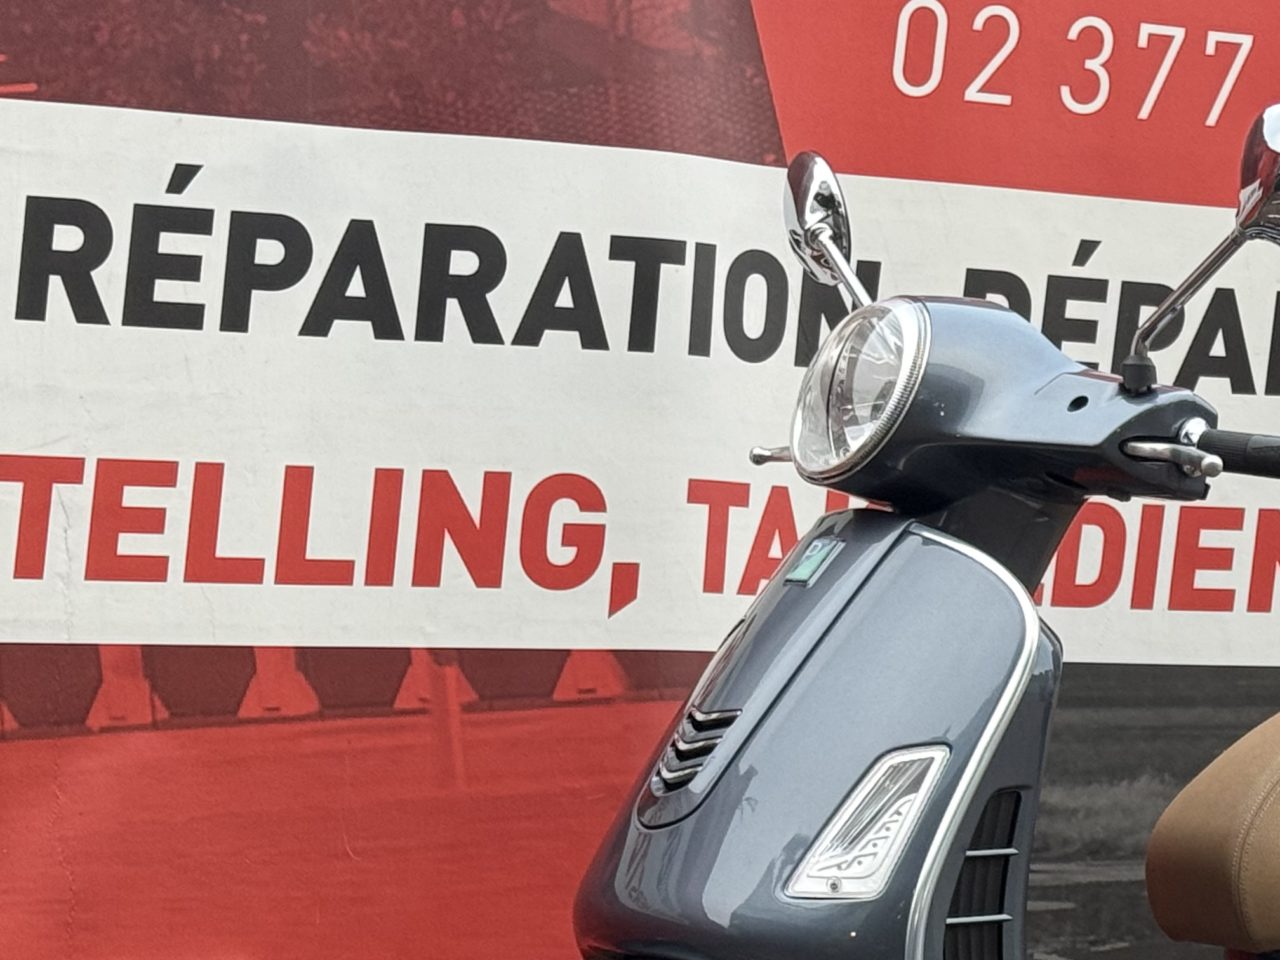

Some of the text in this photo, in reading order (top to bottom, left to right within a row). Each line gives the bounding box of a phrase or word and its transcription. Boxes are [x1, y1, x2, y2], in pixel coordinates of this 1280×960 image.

[893, 0, 1021, 107] 02
[1059, 16, 1253, 127] 377
[0, 454, 640, 620] TELLING,
